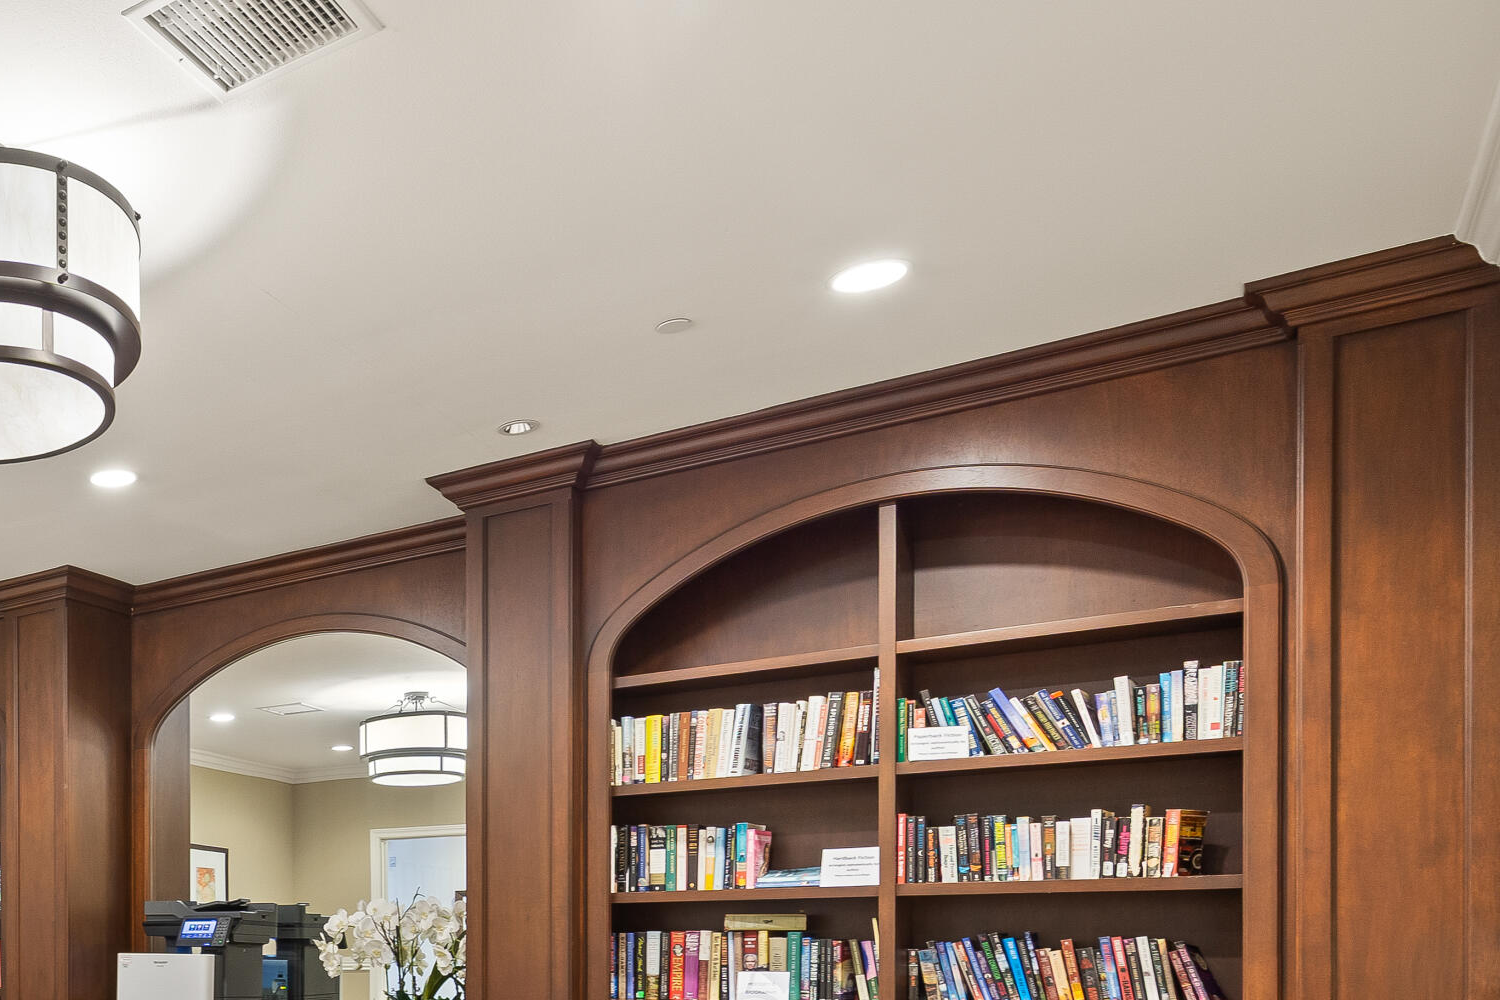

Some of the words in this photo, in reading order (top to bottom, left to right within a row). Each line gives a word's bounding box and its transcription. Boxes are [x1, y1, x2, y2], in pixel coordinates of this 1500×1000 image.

[827, 708, 838, 736] SPLENDID
[823, 749, 831, 760] VILE
[995, 822, 1004, 843] MICHAEL
[996, 845, 1006, 868] CONNELLY
[810, 942, 818, 963] TAKING
[672, 958, 683, 991] EMPIRE
[810, 964, 818, 981] PARIS
